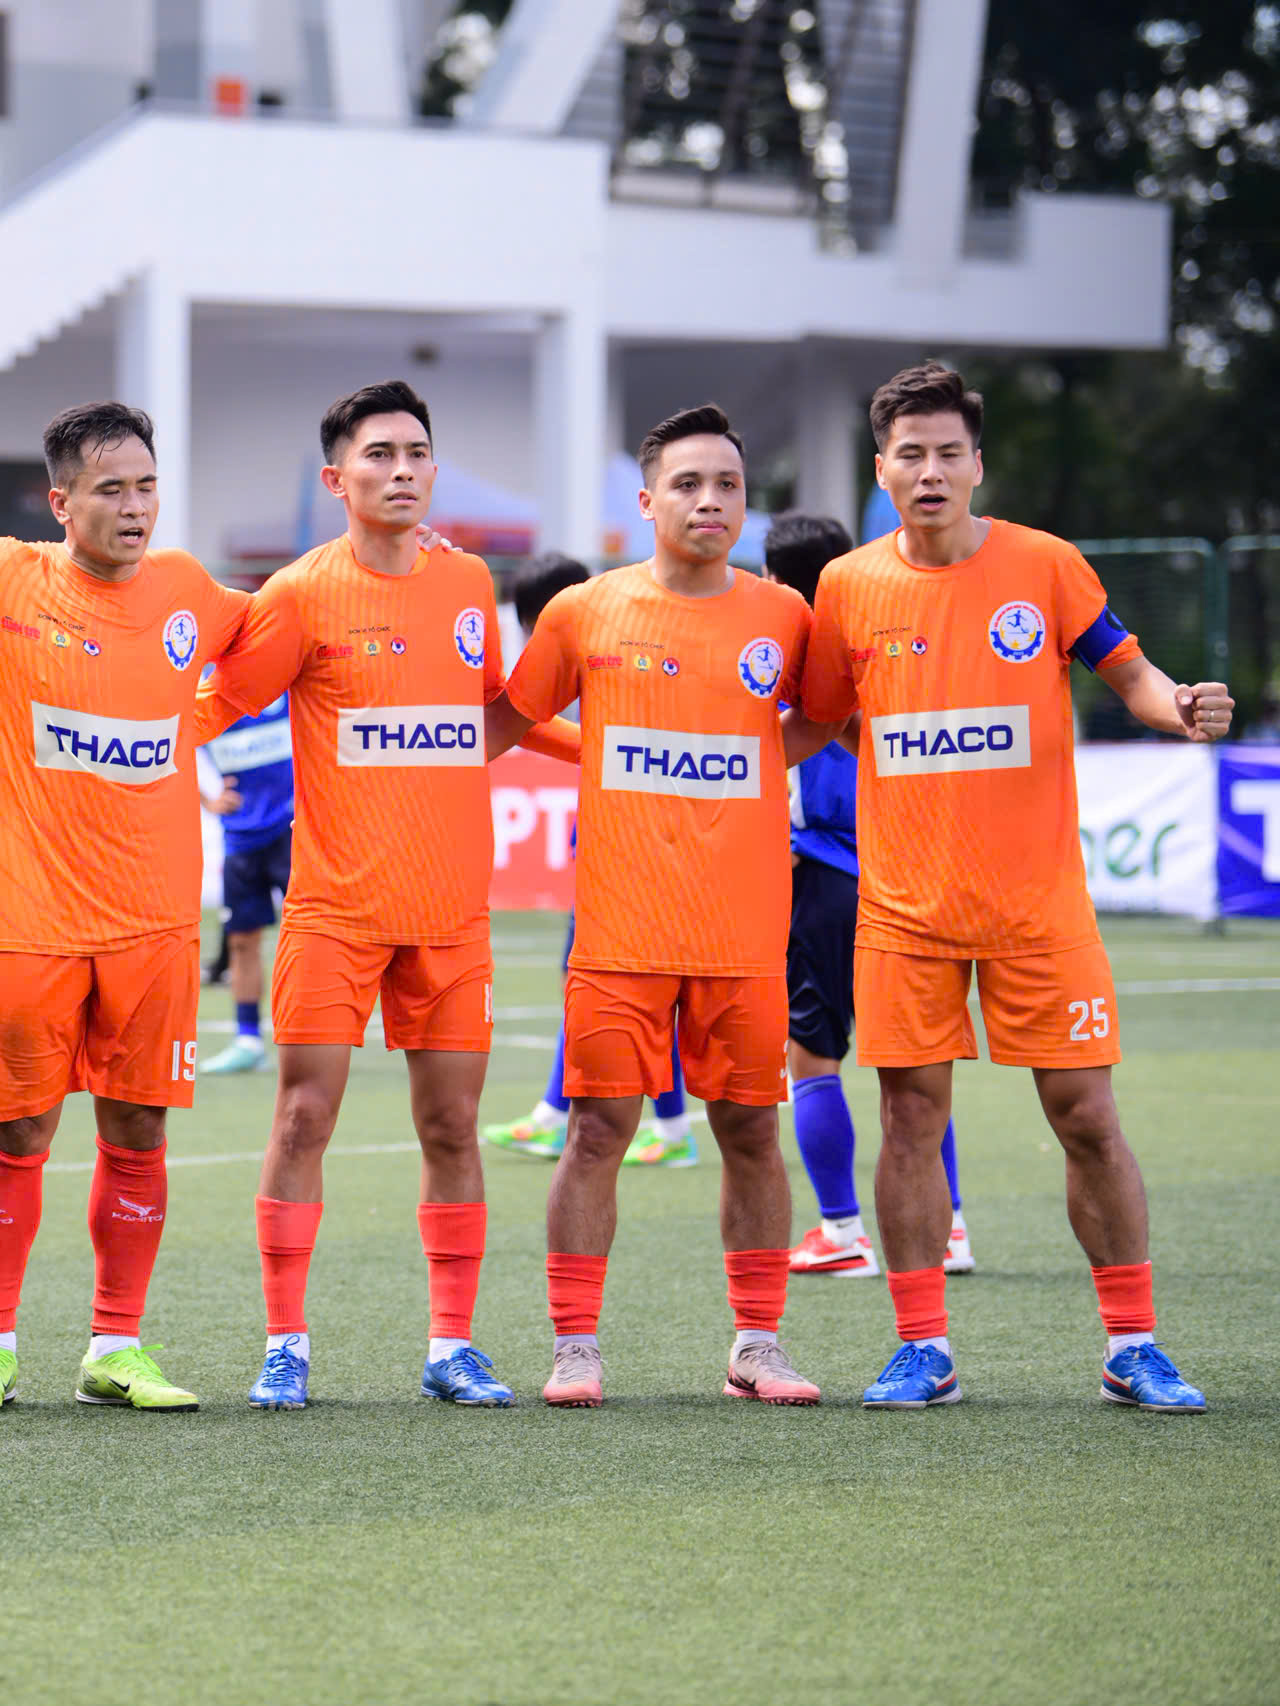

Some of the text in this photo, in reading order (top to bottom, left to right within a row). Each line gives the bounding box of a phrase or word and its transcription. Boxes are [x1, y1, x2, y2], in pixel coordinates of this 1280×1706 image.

[46, 723, 171, 768] THACO
[352, 722, 477, 750] THACO
[883, 724, 1013, 759] THACO
[616, 744, 748, 781] THACO
[1068, 997, 1109, 1041] 25
[172, 1040, 197, 1081] 19
